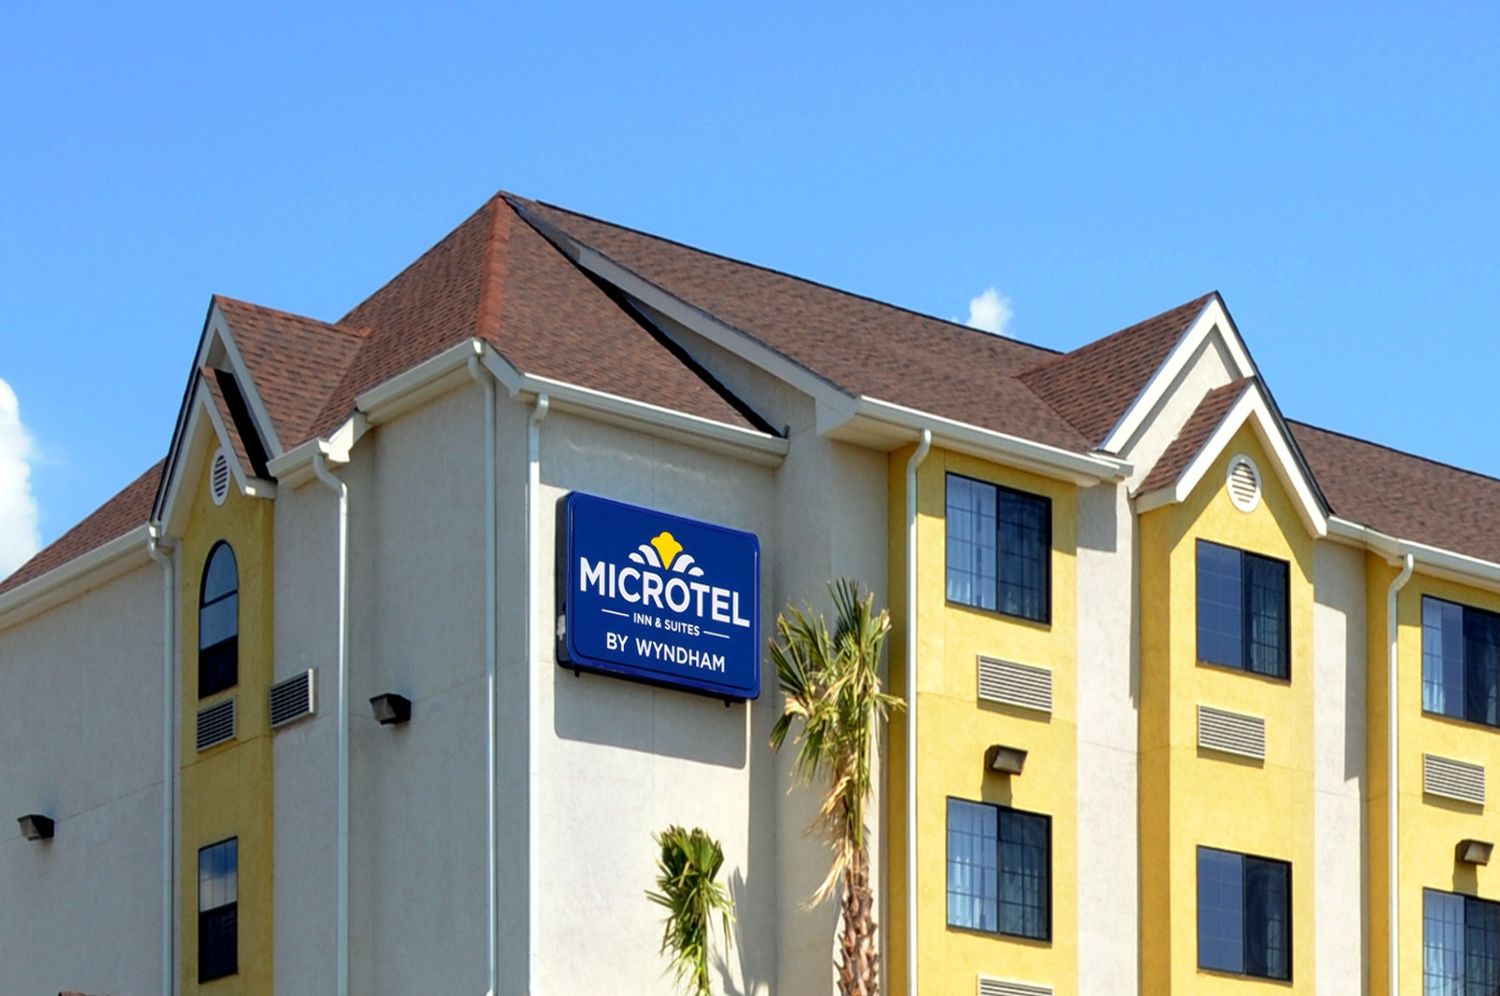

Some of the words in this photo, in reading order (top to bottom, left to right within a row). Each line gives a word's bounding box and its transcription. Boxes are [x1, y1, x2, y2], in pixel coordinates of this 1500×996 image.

[580, 556, 750, 628] MICROTEL
[633, 612, 652, 627] INN
[654, 617, 662, 628] &
[664, 618, 700, 637] SUITES
[606, 632, 629, 652] BY
[636, 637, 725, 673] WYNDHAM
